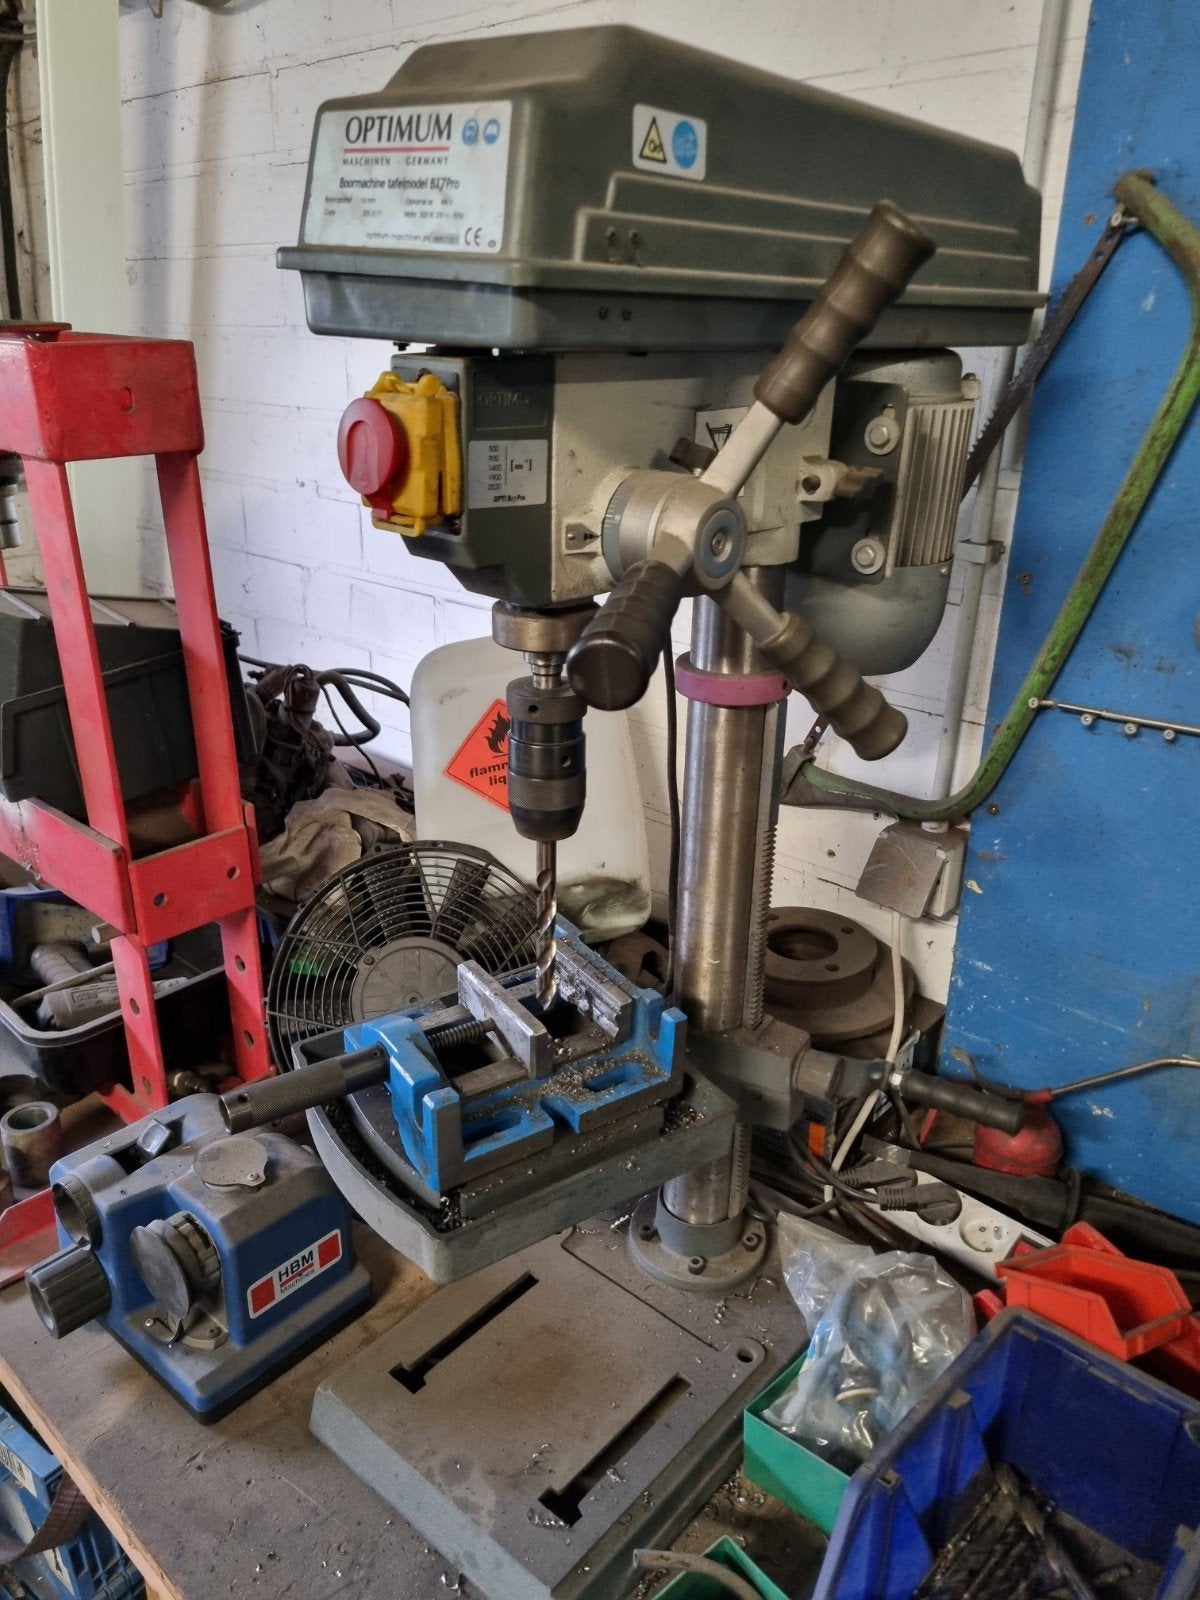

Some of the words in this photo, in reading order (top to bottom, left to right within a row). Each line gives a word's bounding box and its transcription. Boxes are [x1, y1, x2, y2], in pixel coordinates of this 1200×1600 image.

[345, 114, 452, 144] OPTIMUM
[343, 157, 391, 166] MASCHINEN
[405, 156, 450, 166] GERMANY
[339, 178, 386, 189] Boormachine
[388, 177, 428, 190] tafelmodel
[278, 1250, 314, 1282] HBM
